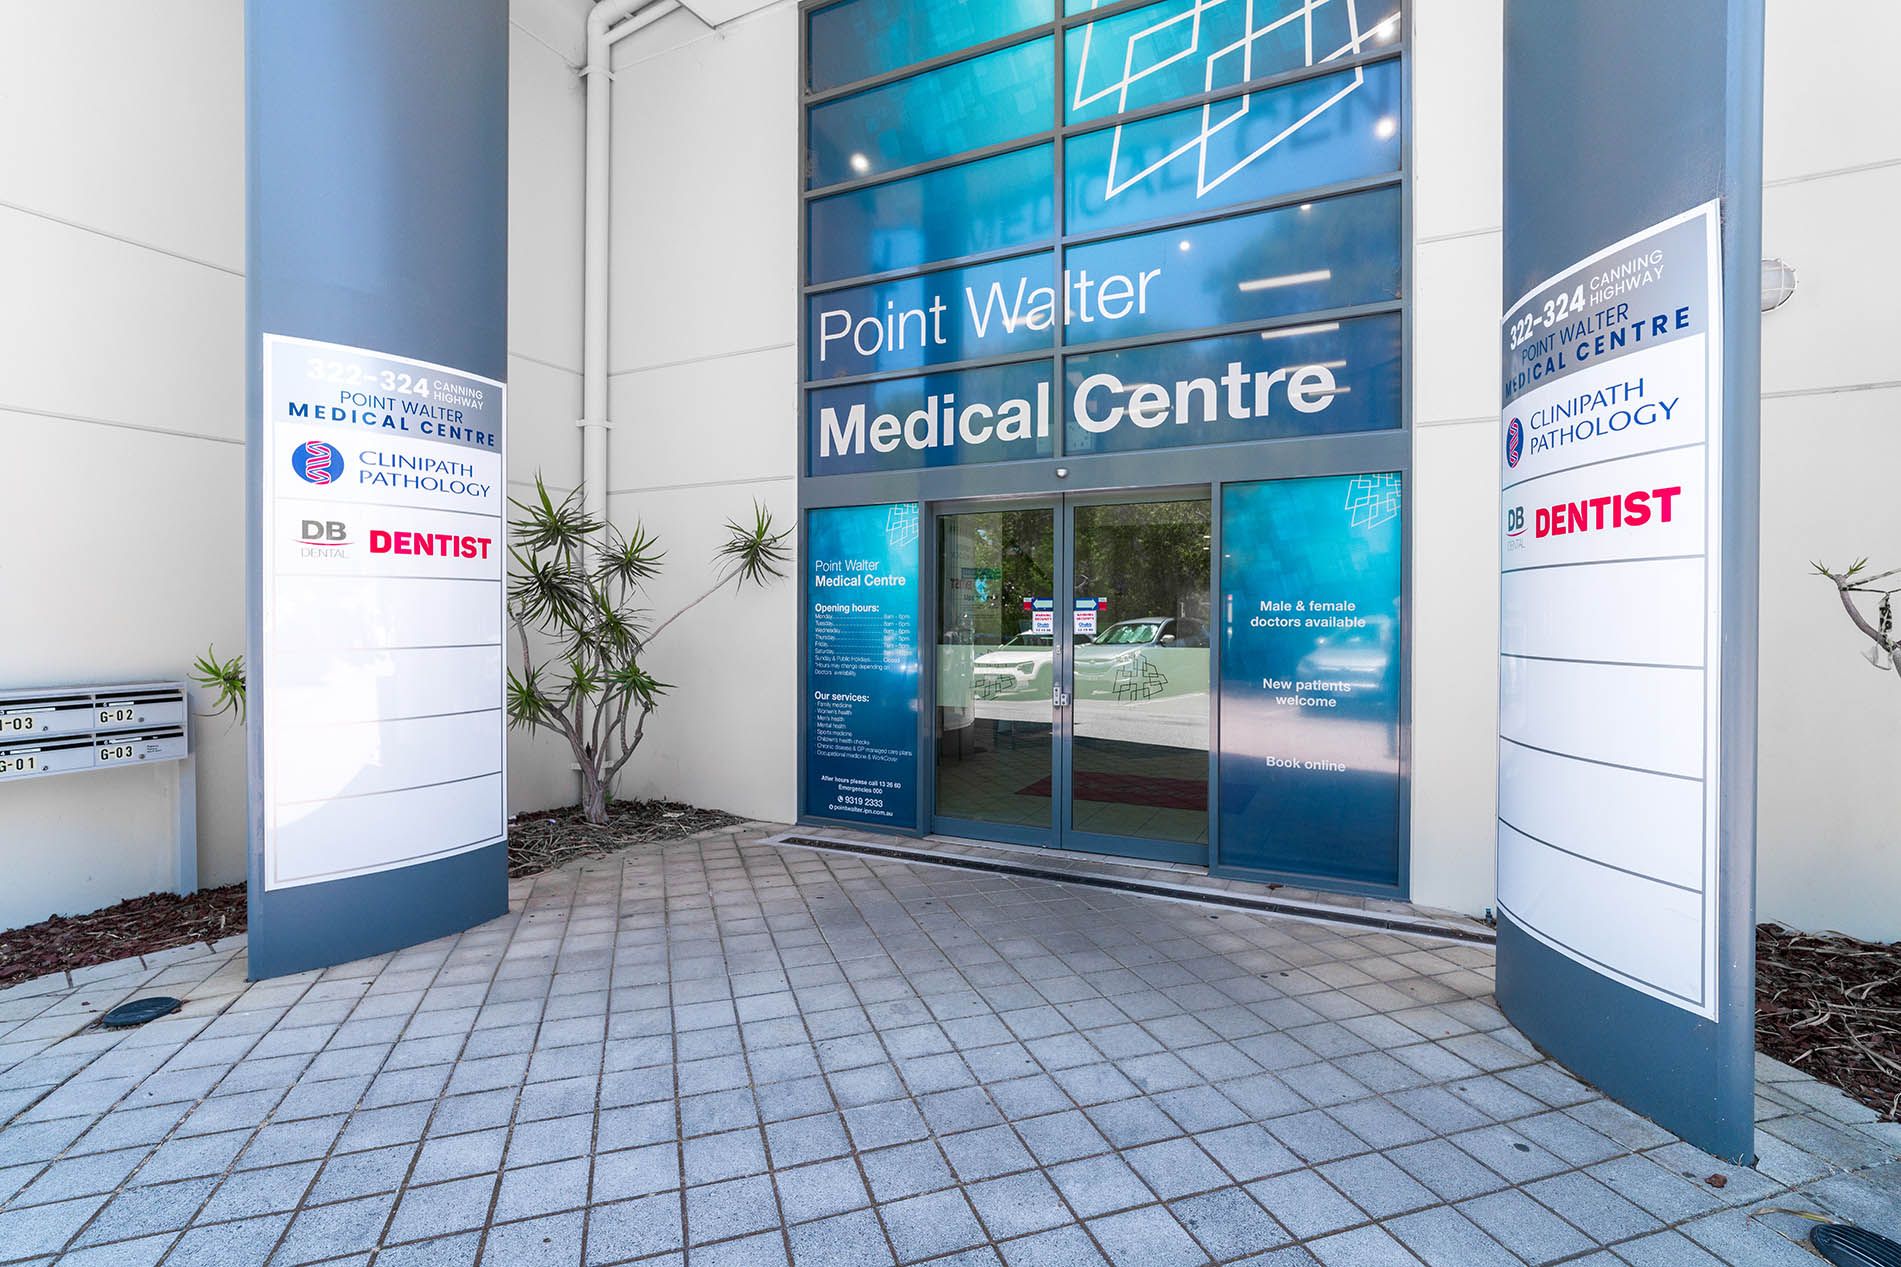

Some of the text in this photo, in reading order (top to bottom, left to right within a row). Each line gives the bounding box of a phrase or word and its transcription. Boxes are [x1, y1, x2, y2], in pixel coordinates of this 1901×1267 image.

[1590, 249, 1663, 290] CANNING
[1590, 264, 1664, 307] HIGHWAY
[819, 269, 1161, 361] Point Walter
[1510, 284, 1586, 350] 322-324
[1522, 302, 1628, 365] POINT WALTER
[1505, 306, 1689, 399] MEDICAL CENTRE
[306, 358, 429, 397] 322-324
[434, 380, 483, 399] CANNING
[340, 391, 463, 424] POINT WALTER
[434, 392, 483, 410] HIGHWAY
[819, 362, 1336, 457] Medical Centre
[1530, 378, 1644, 430] CLINIPATH
[289, 402, 494, 446] MEDICAL CENTRE
[1530, 397, 1679, 455] PATHOLOGY
[359, 451, 473, 477] CLINIPATH
[360, 470, 490, 497] PATHOLOGY
[1508, 506, 1524, 532] DB
[1535, 486, 1681, 538] DENTIST
[302, 520, 346, 540] DB
[301, 548, 347, 559] DENTAL
[370, 530, 491, 559] DENTIST
[816, 559, 879, 572] Point Walter
[816, 574, 906, 587] Medical Centre
[815, 603, 879, 613] Opening hours:
[1260, 601, 1356, 611] Male & female
[1250, 616, 1365, 628] doctors available
[1263, 678, 1351, 693] New patients
[815, 691, 869, 702] Our services:
[1276, 696, 1337, 707] welcome
[100, 709, 133, 723] G-02
[101, 746, 132, 760] G-03
[817, 750, 846, 758] Occupational
[1266, 756, 1346, 772] Book online
[838, 784, 872, 793] Emergencies
[850, 777, 867, 785] please
[845, 796, 883, 807] 9319 2333
